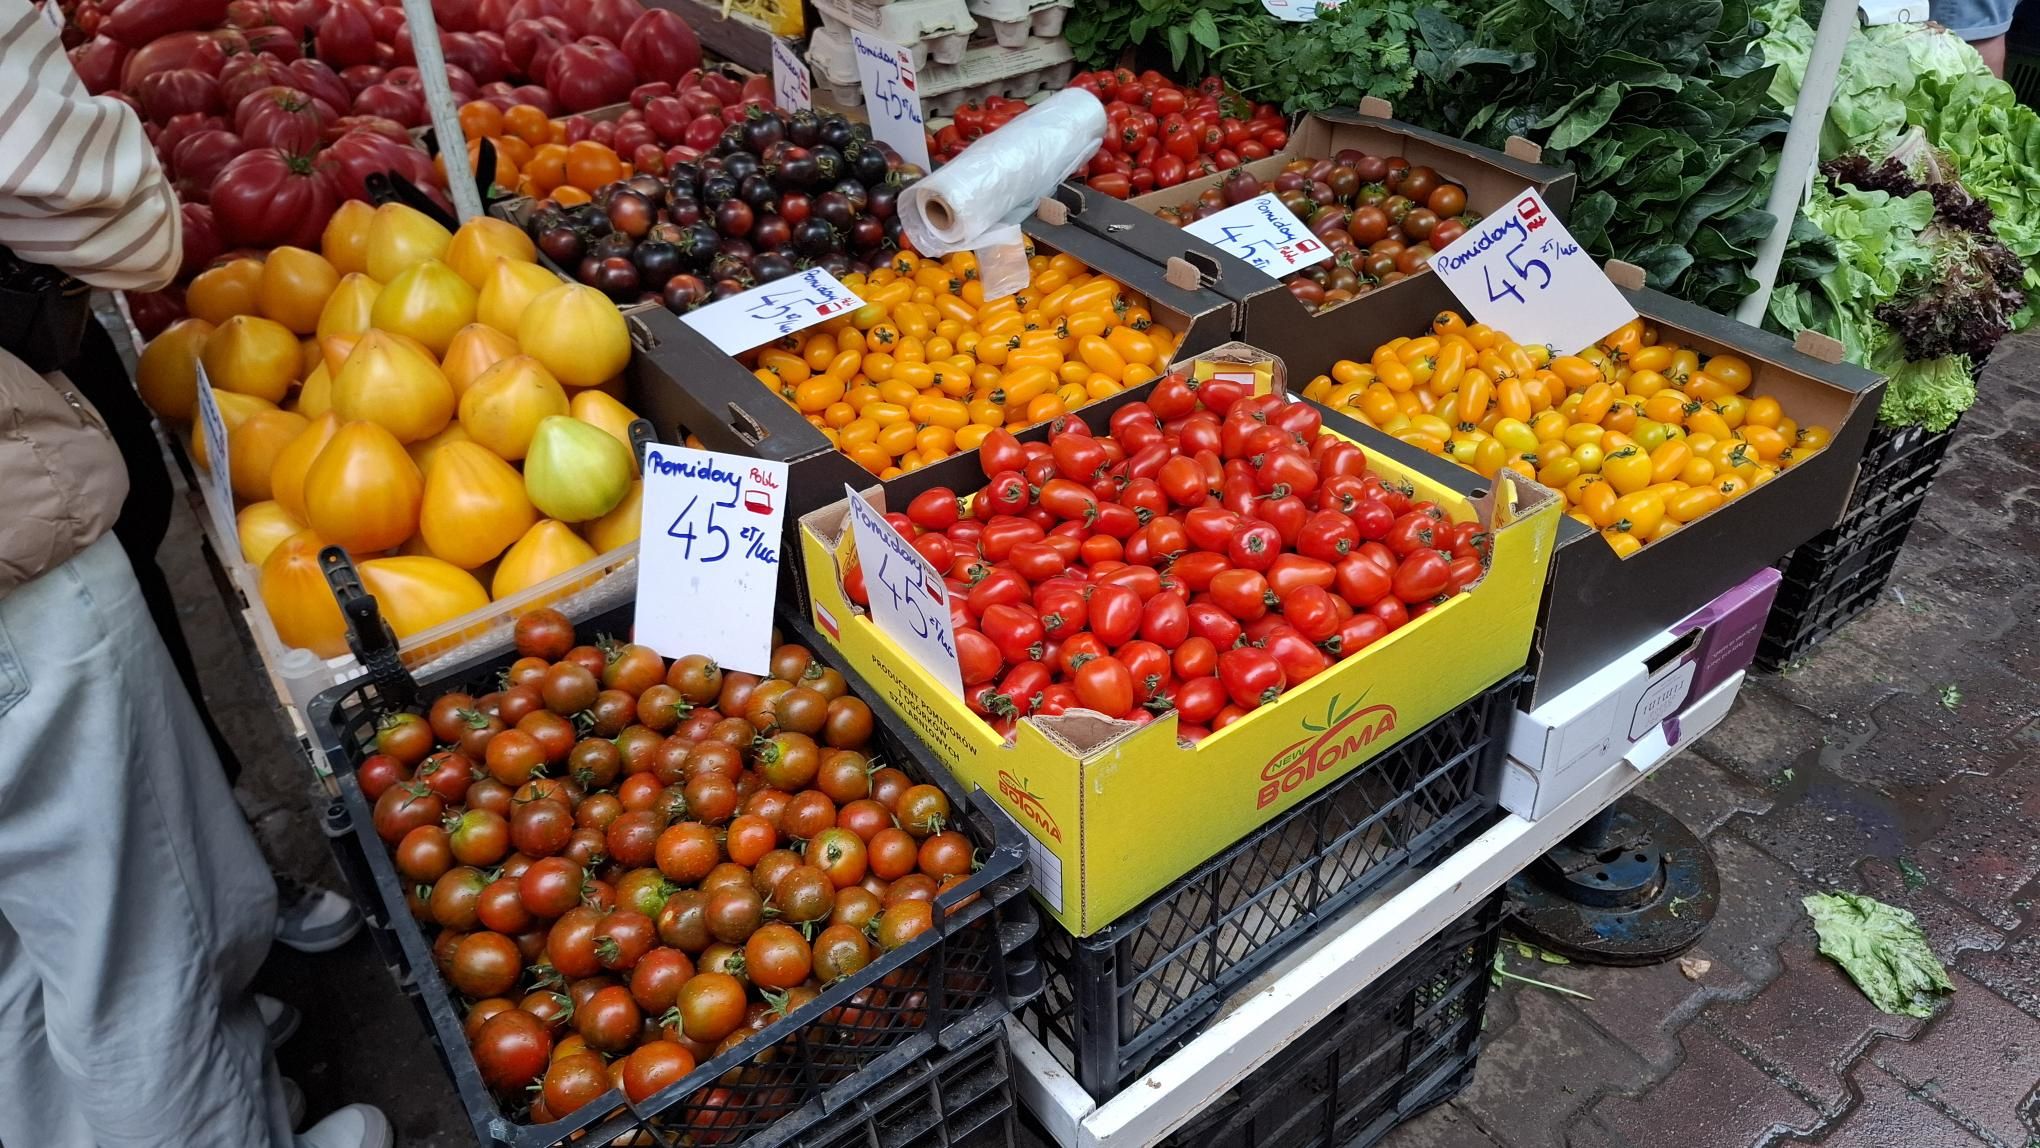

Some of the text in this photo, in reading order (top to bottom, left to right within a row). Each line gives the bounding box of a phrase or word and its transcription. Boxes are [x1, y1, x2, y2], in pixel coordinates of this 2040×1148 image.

[876, 70, 902, 120] 45
[1213, 225, 1279, 260] 45
[1484, 243, 1551, 304] 45
[745, 290, 816, 320] 45
[667, 495, 730, 562] 45
[878, 553, 929, 639] 45
[871, 654, 918, 702] PRODUCENT
[920, 699, 978, 756] POMIDORÓW
[889, 691, 960, 761] SZKLARNIOWYCH
[904, 695, 947, 738] OGÓRKÓW
[1257, 713, 1396, 810] BOTOMA
[1271, 746, 1306, 772] NEW
[998, 779, 1062, 844] BOTOMA
